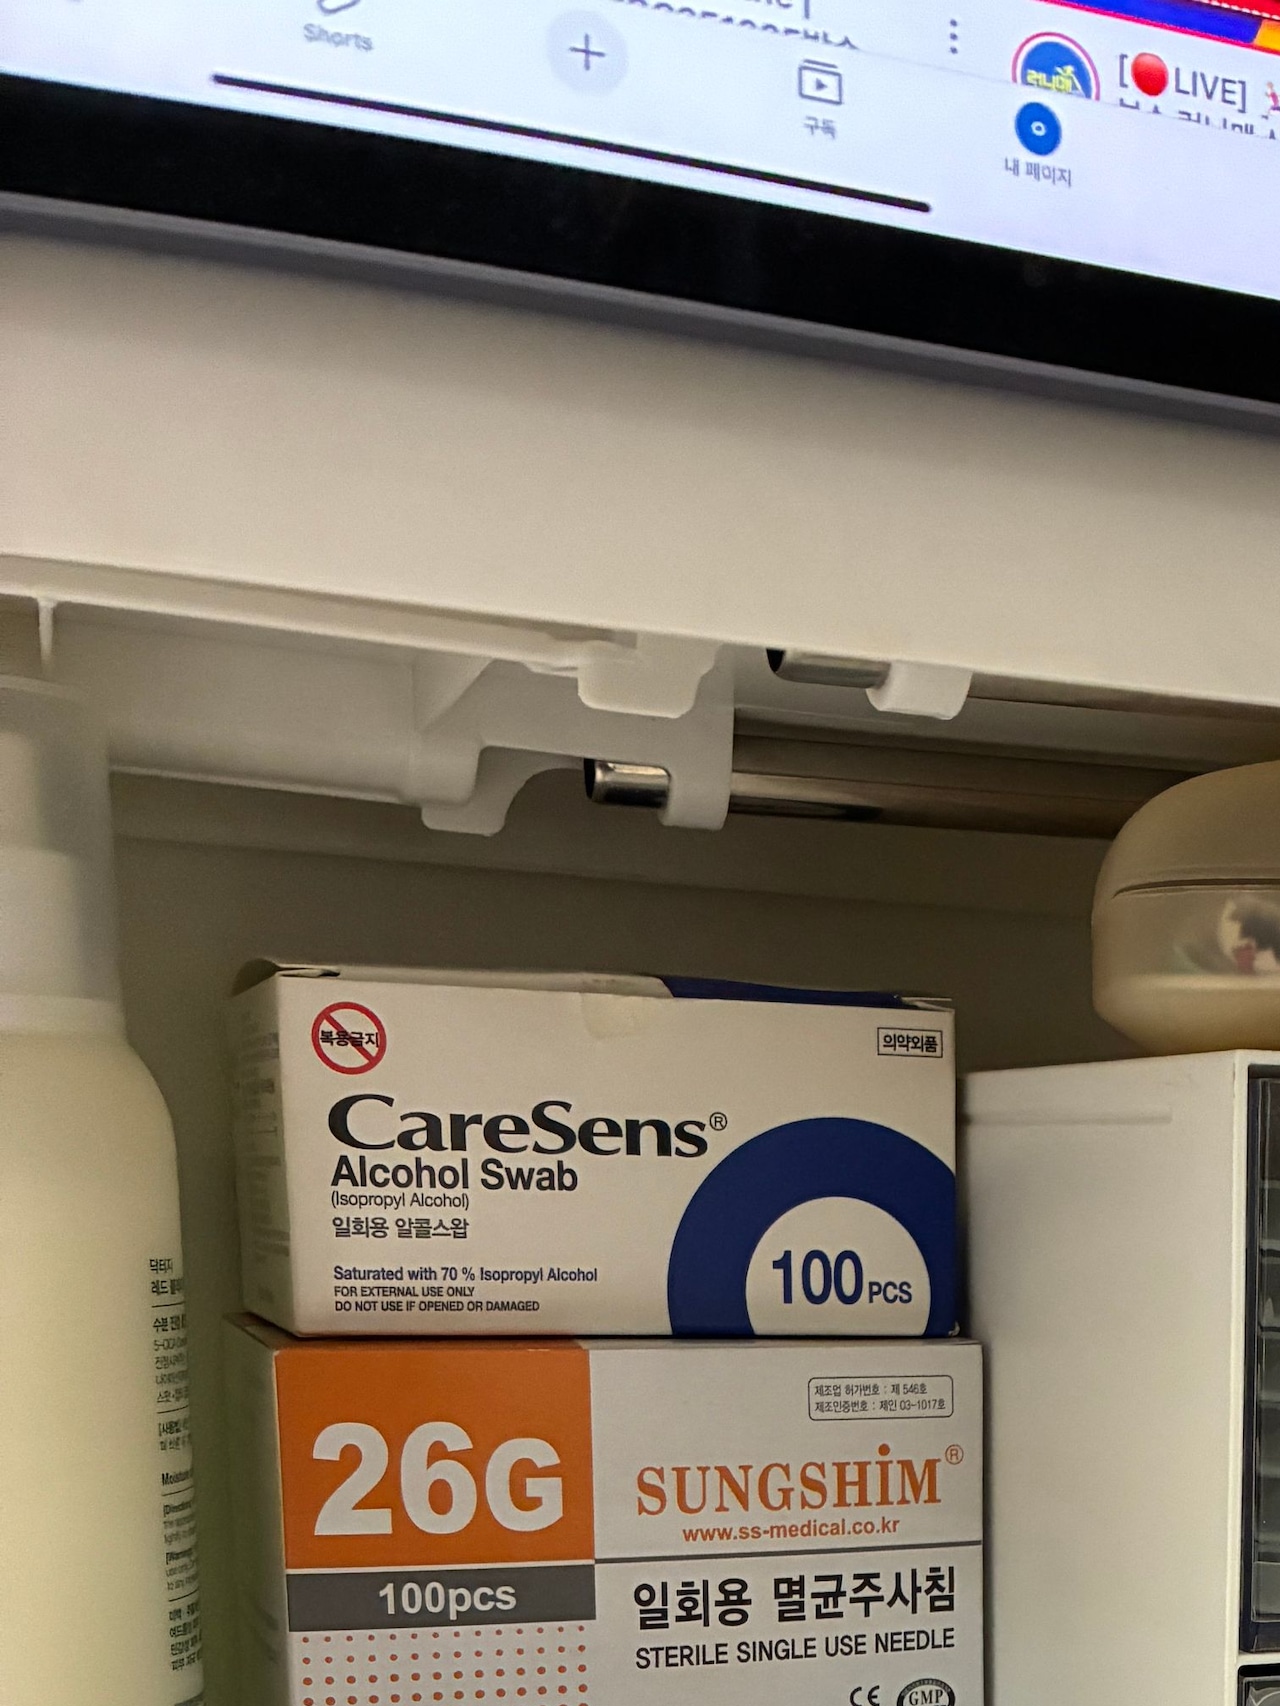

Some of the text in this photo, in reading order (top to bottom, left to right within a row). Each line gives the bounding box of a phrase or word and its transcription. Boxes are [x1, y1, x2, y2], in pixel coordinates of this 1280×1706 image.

[303, 22, 373, 53] Shorts
[803, 115, 838, 139] 구독
[1004, 157, 1072, 188] 내 페이지
[319, 1027, 380, 1049] 복용금지
[882, 1031, 940, 1054] 의약외품
[330, 1154, 578, 1193] Alcohol Swab
[331, 1191, 469, 1210] (Isopropyl Alcohol)
[332, 1217, 469, 1239] 일회용 알콜스왑
[334, 1266, 598, 1284] Saturated with 70 % Isopropyl Alcohol
[334, 1286, 475, 1297] FOR EXTERNAL USE ONLY
[869, 1281, 912, 1304] PCS
[335, 1301, 540, 1311] DO NOT USE IF OPENED OR DAMAGED
[814, 1385, 841, 1397] 제조업
[845, 1384, 880, 1397] 허가번호
[891, 1384, 899, 1394] 제
[815, 1401, 868, 1413] 제조인증번호
[879, 1399, 897, 1411] 제인
[312, 1421, 564, 1537] 26G
[682, 1516, 901, 1545] www.ss-medical.co.kr
[378, 1580, 517, 1620] 100pcs
[632, 1564, 957, 1630] 일회용 멸균주사침
[635, 1627, 956, 1670] STERILE SINGLE USE NEEDLE
[908, 1689, 944, 1706] GMP
